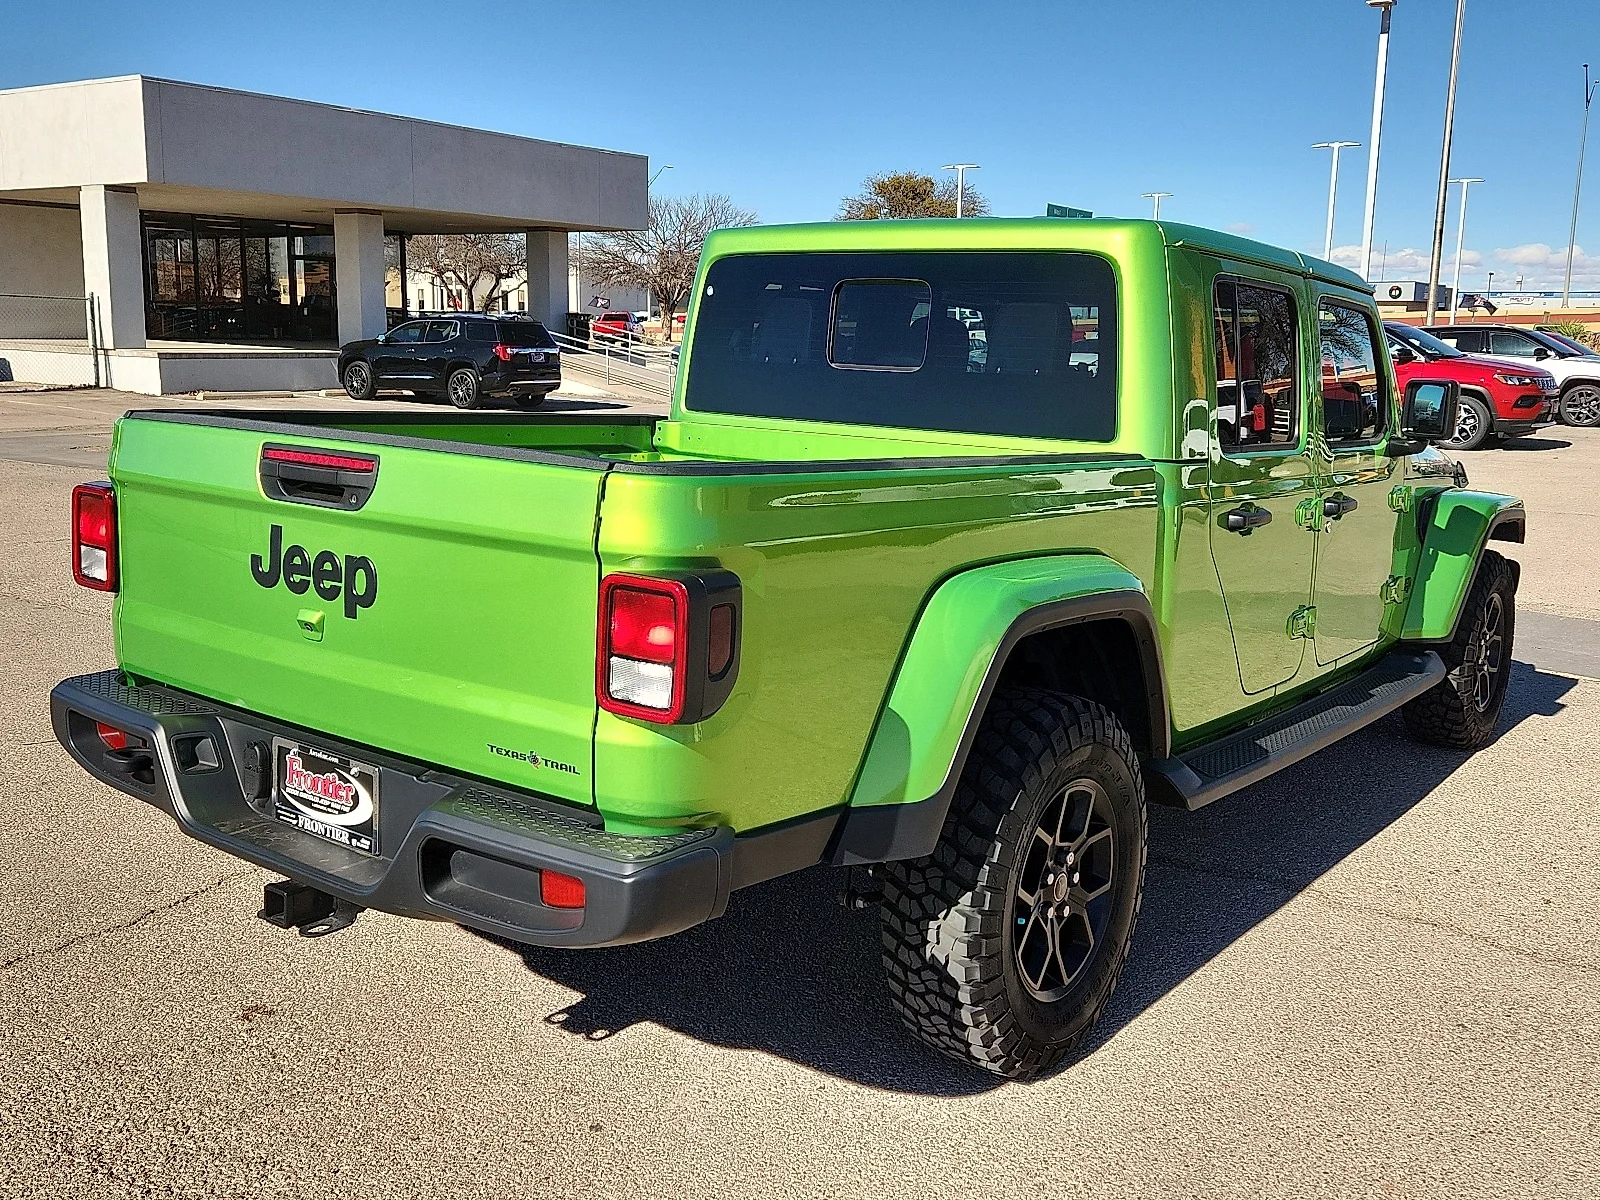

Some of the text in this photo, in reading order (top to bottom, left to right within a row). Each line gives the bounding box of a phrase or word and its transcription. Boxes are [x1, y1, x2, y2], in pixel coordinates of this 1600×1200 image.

[250, 524, 378, 619] Jeep
[286, 755, 355, 804] Frontier
[487, 743, 581, 776] TEXAS TRAIL
[298, 815, 350, 844] FRONTIER
